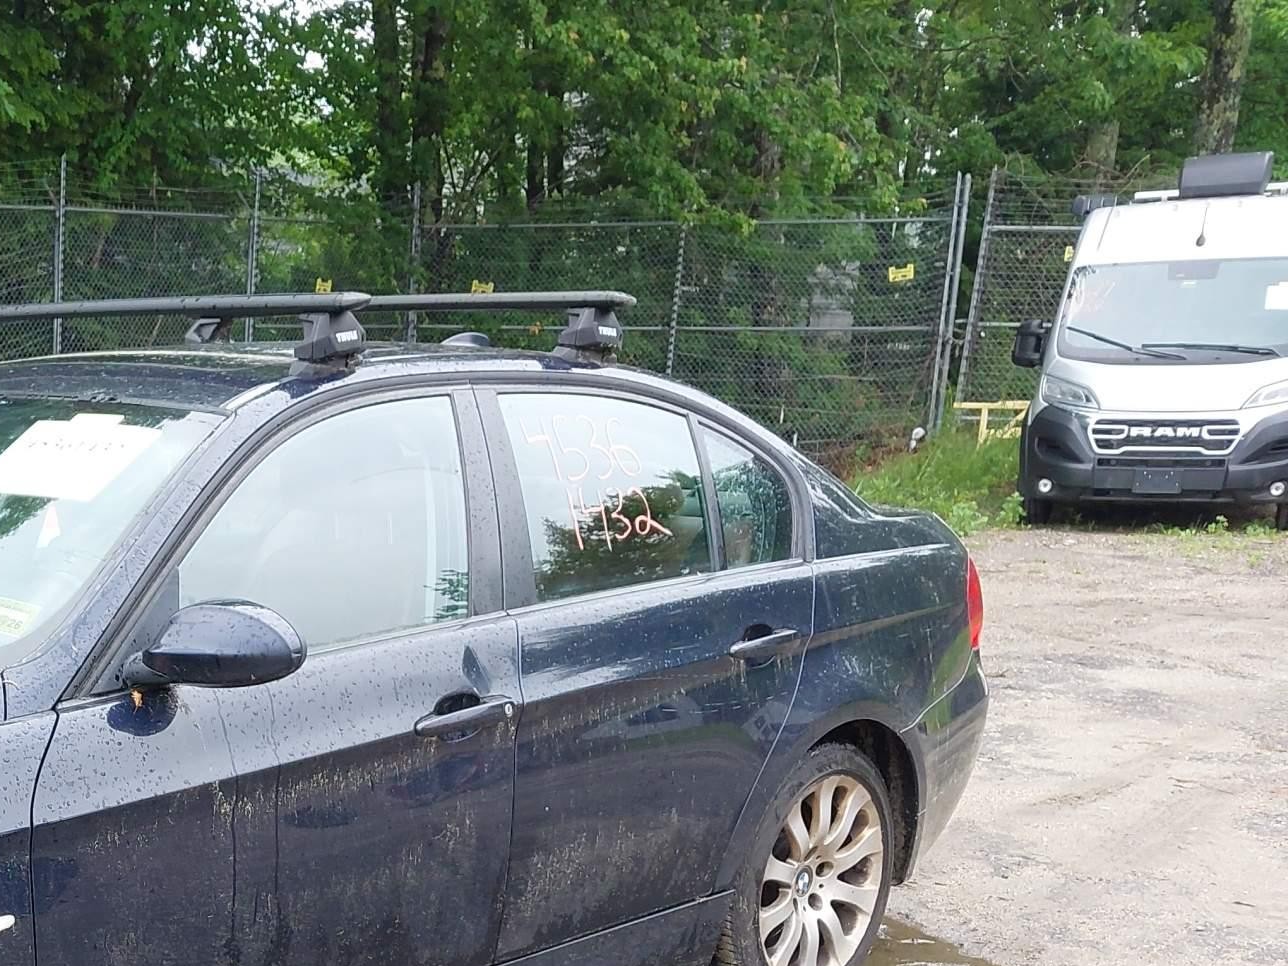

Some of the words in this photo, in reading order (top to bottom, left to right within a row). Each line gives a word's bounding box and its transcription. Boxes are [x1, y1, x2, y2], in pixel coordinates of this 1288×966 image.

[520, 414, 642, 481] 4536
[1130, 426, 1201, 438] RAM
[567, 486, 673, 552] 1432
